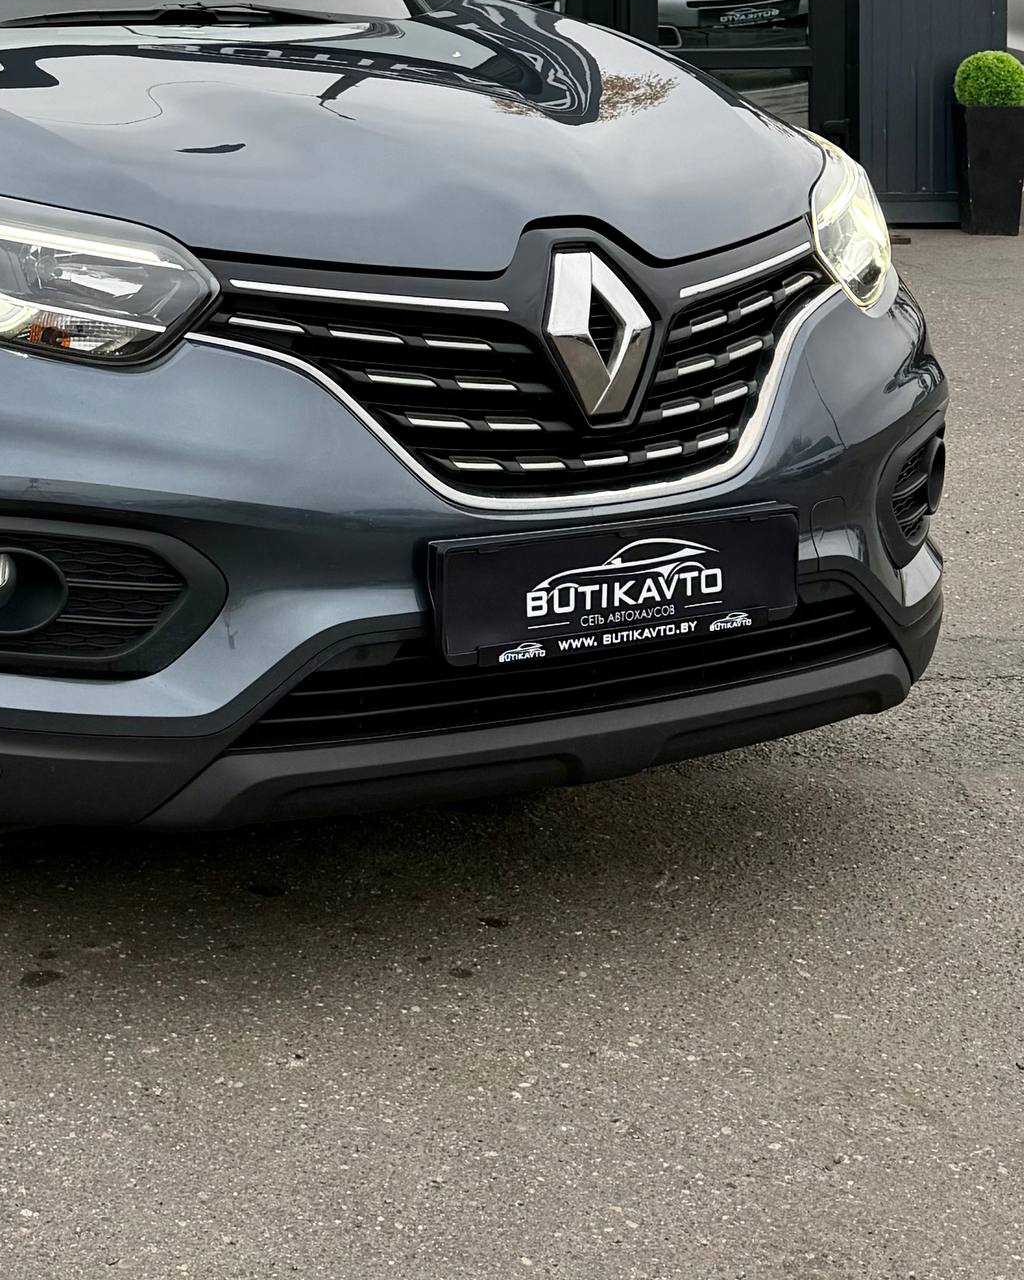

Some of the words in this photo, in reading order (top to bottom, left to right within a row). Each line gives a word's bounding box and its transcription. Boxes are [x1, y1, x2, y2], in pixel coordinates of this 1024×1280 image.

[526, 568, 723, 617] BUTIKAVTO
[580, 611, 606, 627] СЕТЬ
[607, 603, 676, 624] АВТОХАУСОВ
[708, 616, 753, 632] BUTIKAVTO
[558, 634, 599, 652] WWW.
[602, 620, 698, 646] BUTIKAVTO.BY
[498, 648, 546, 663] BUTIKAVTO
